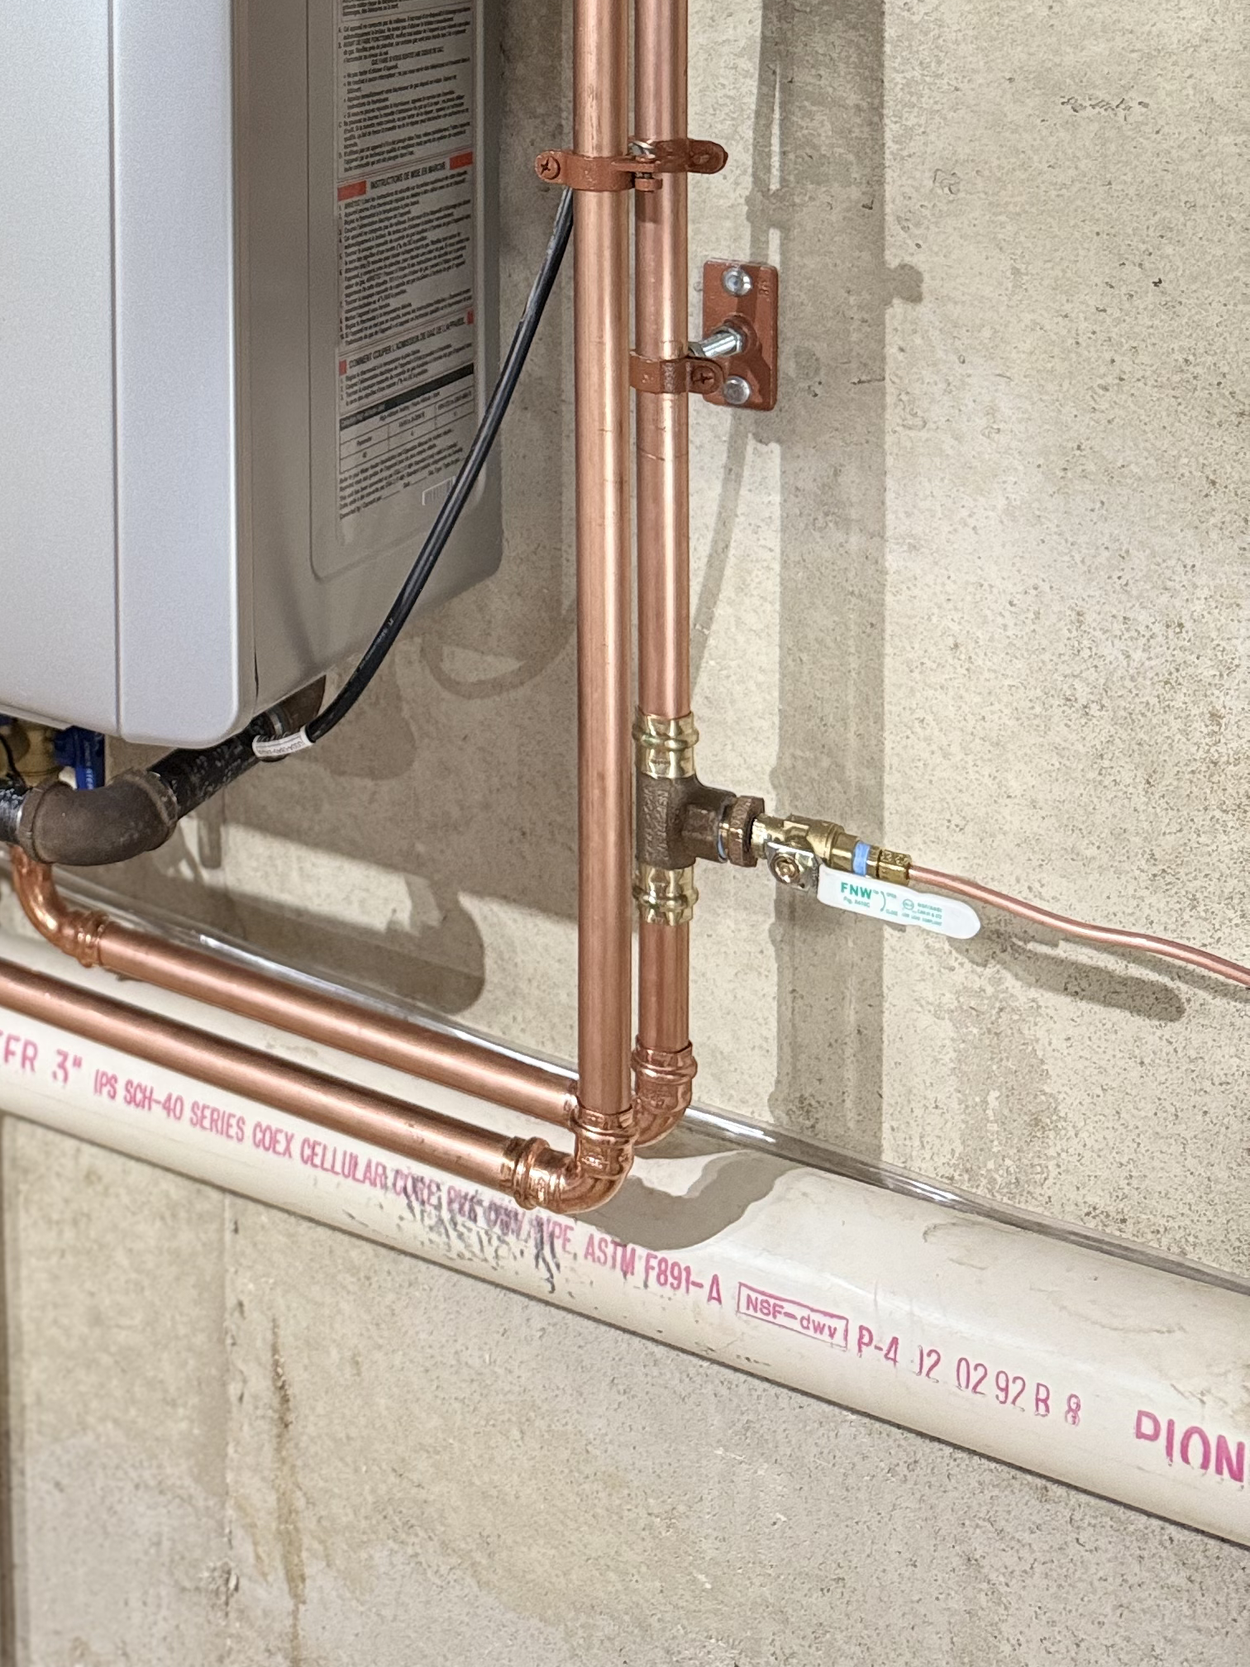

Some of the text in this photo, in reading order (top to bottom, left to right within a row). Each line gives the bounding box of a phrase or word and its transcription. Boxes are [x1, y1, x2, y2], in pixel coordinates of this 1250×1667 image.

[840, 882, 872, 899] FNW
[93, 1069, 118, 1100] IPS
[123, 1079, 185, 1122] SCH-40
[190, 1101, 246, 1143] SERIES
[252, 1121, 294, 1160] COEX
[300, 1137, 387, 1189] CELLULAR
[584, 1239, 636, 1277] ASTM
[644, 1252, 723, 1306] F891-A
[746, 1292, 838, 1342] NSF-dwv
[857, 1325, 899, 1367] P-4
